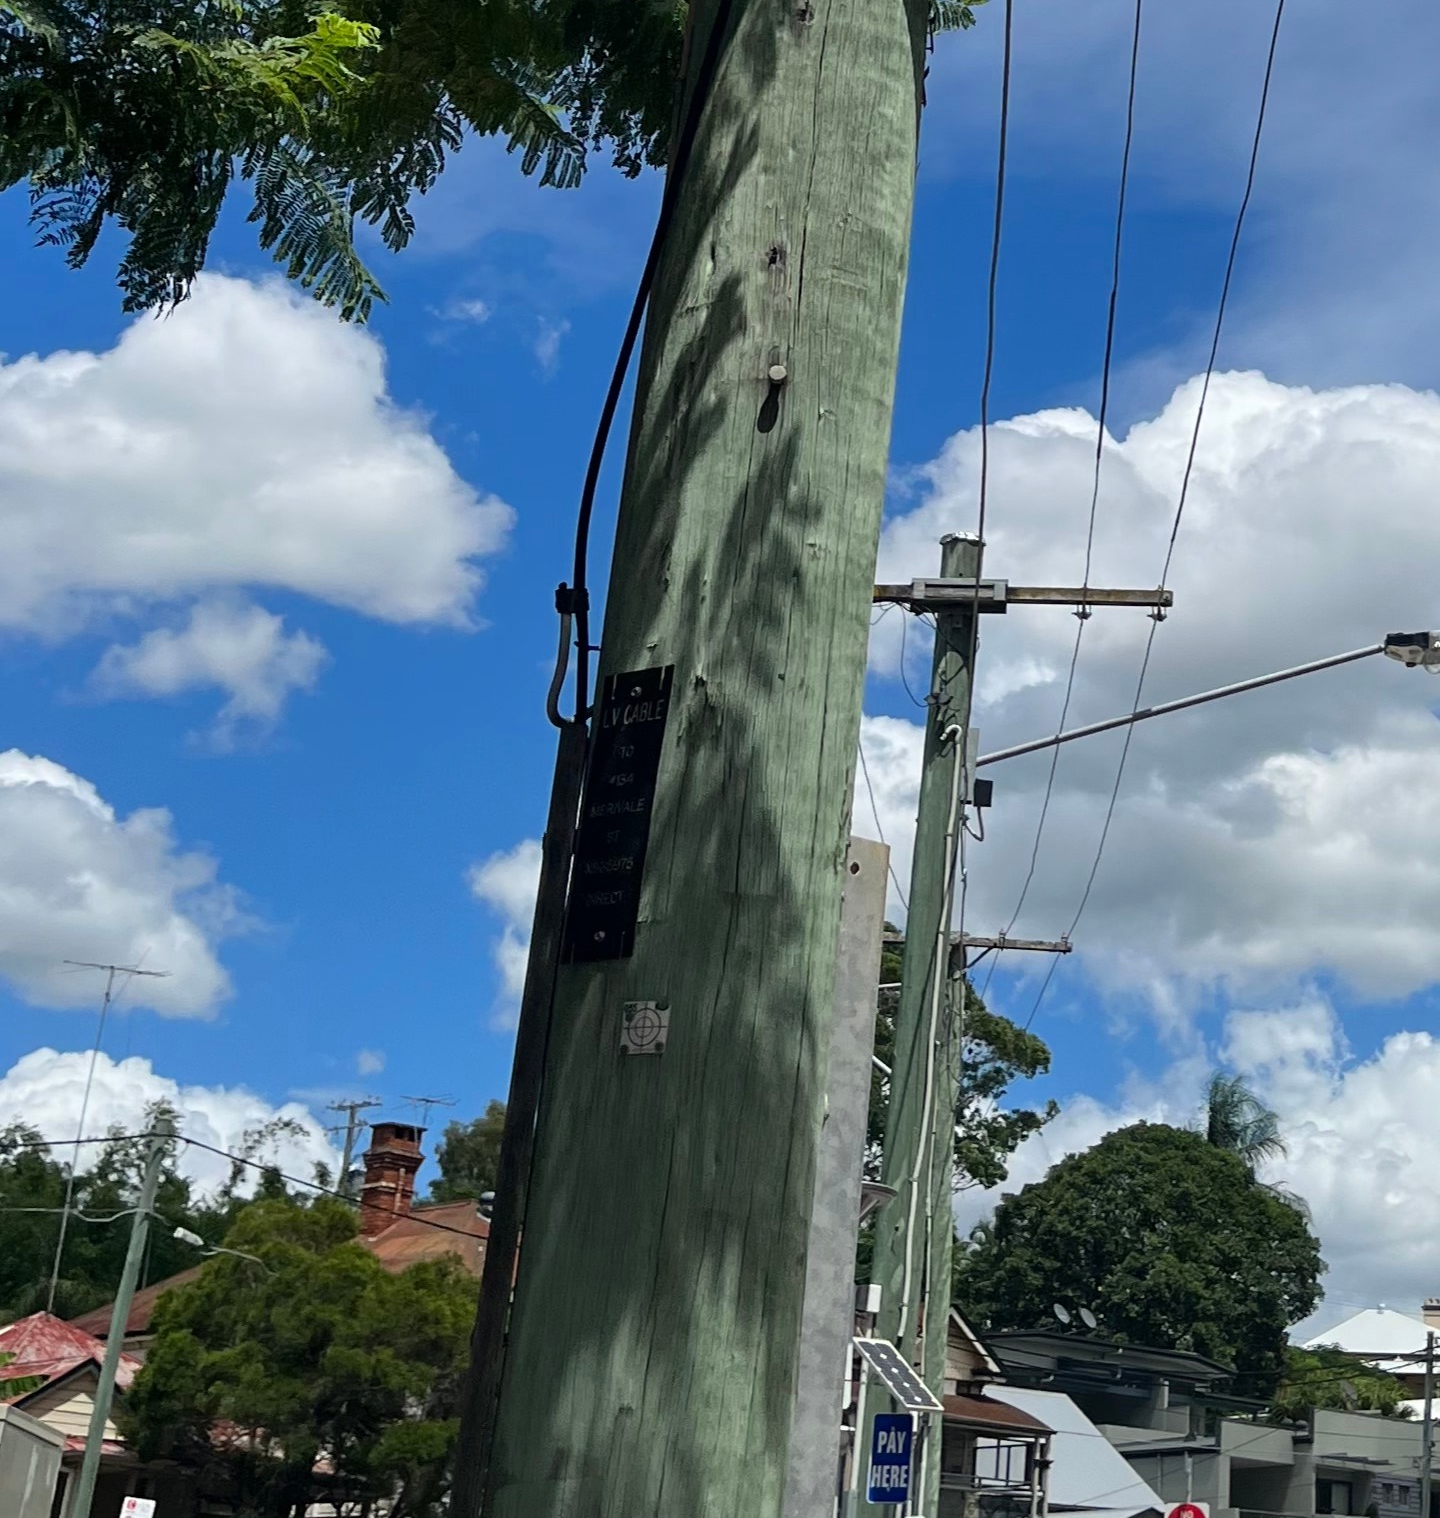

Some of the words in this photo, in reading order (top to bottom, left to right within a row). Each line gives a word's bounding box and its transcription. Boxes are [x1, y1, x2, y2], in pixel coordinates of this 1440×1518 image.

[623, 698, 666, 726] CABLE
[876, 1430, 907, 1454] PAY
[871, 1465, 909, 1489] HERE
